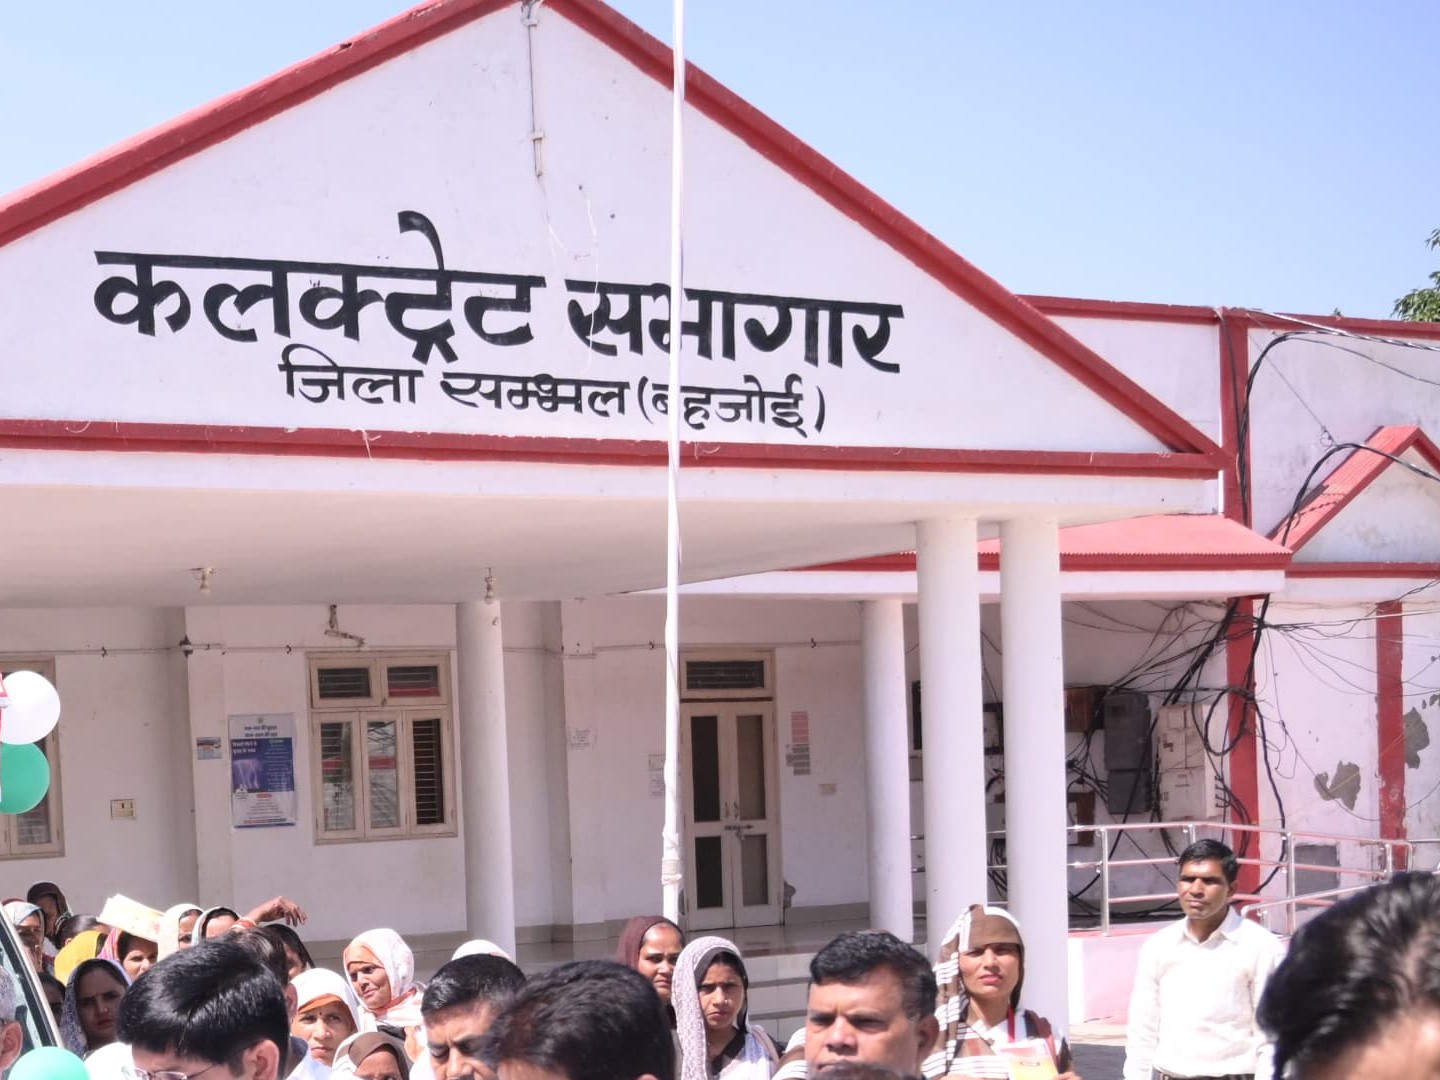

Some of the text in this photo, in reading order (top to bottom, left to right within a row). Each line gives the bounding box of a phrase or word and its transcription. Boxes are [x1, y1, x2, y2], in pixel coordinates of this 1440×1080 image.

[94, 211, 904, 373] कलक्ट्रेट सभागार
[278, 344, 424, 403] जिला
